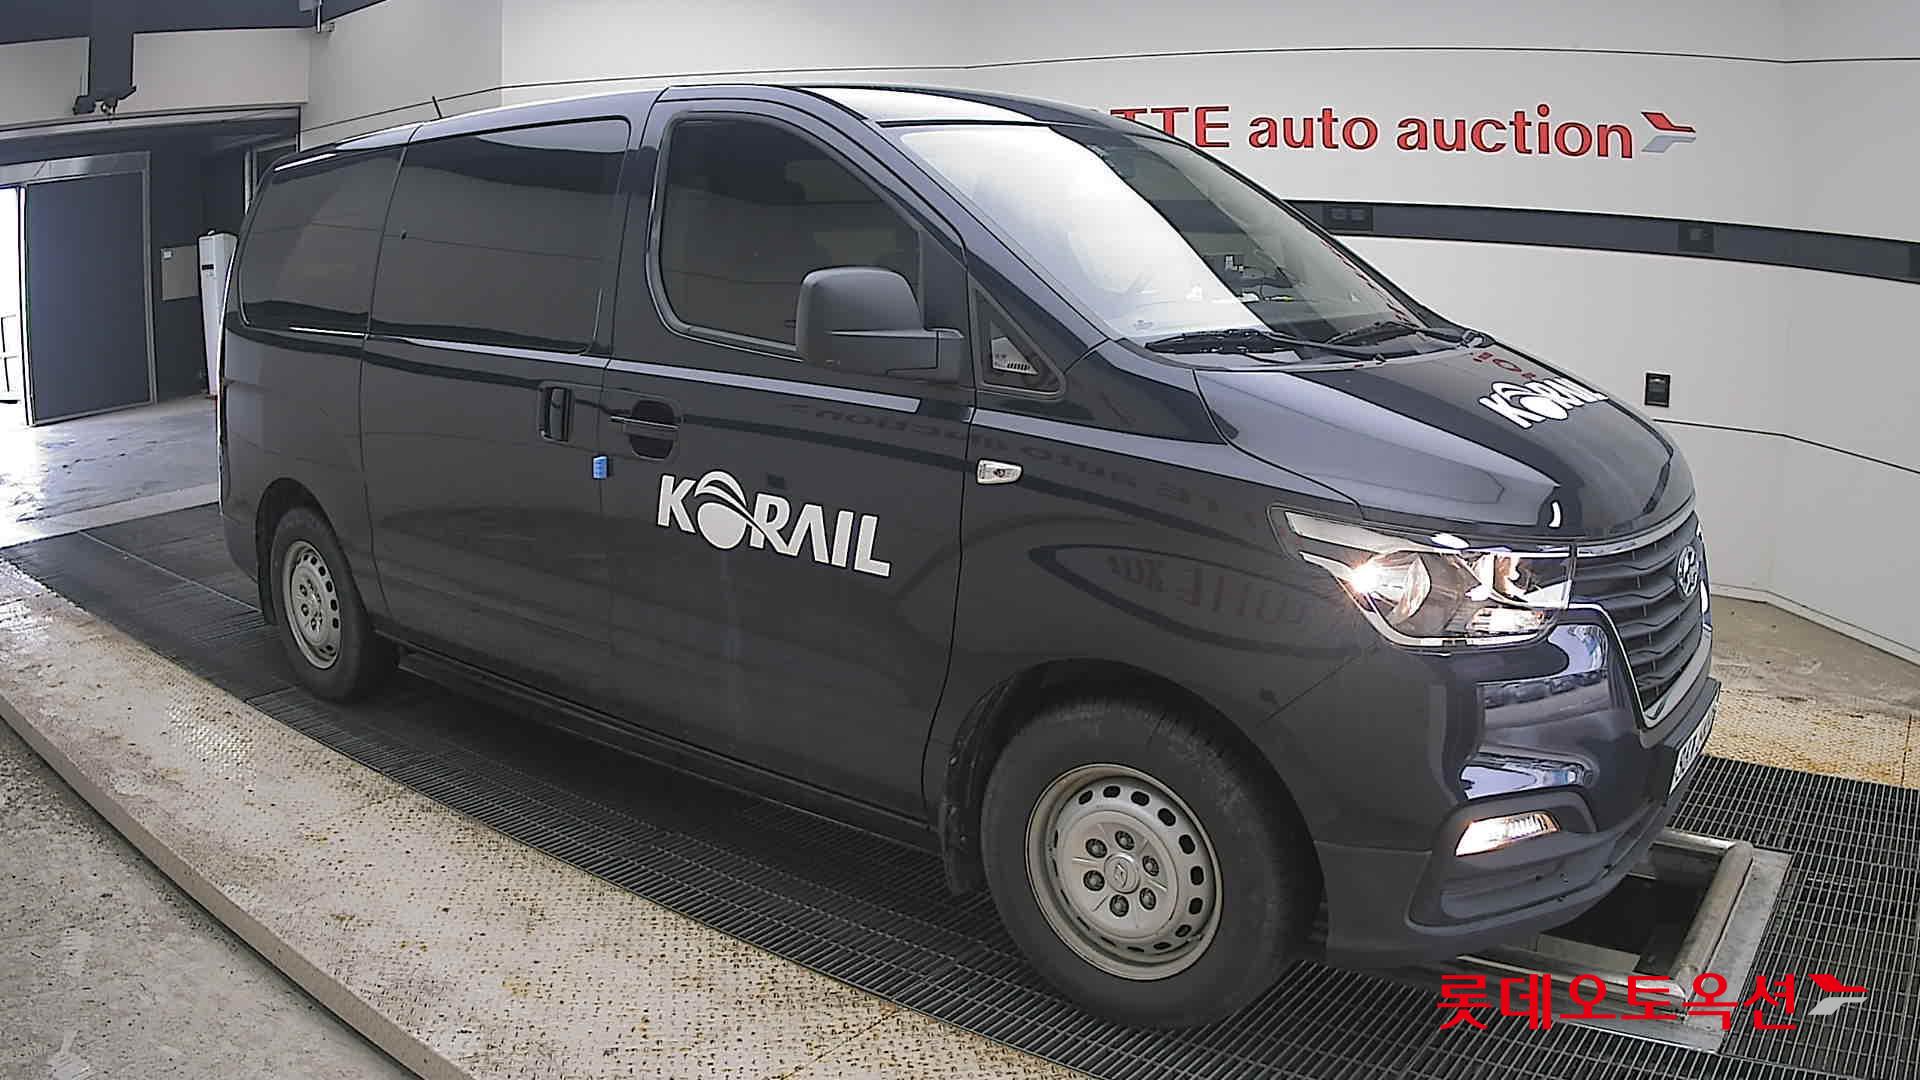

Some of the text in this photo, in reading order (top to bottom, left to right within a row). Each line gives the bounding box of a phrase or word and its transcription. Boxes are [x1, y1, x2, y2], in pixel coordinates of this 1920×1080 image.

[1248, 107, 1379, 149] auto
[1396, 104, 1633, 159] auction
[1479, 376, 1609, 429] KORAIL
[657, 470, 891, 577] KORAIL
